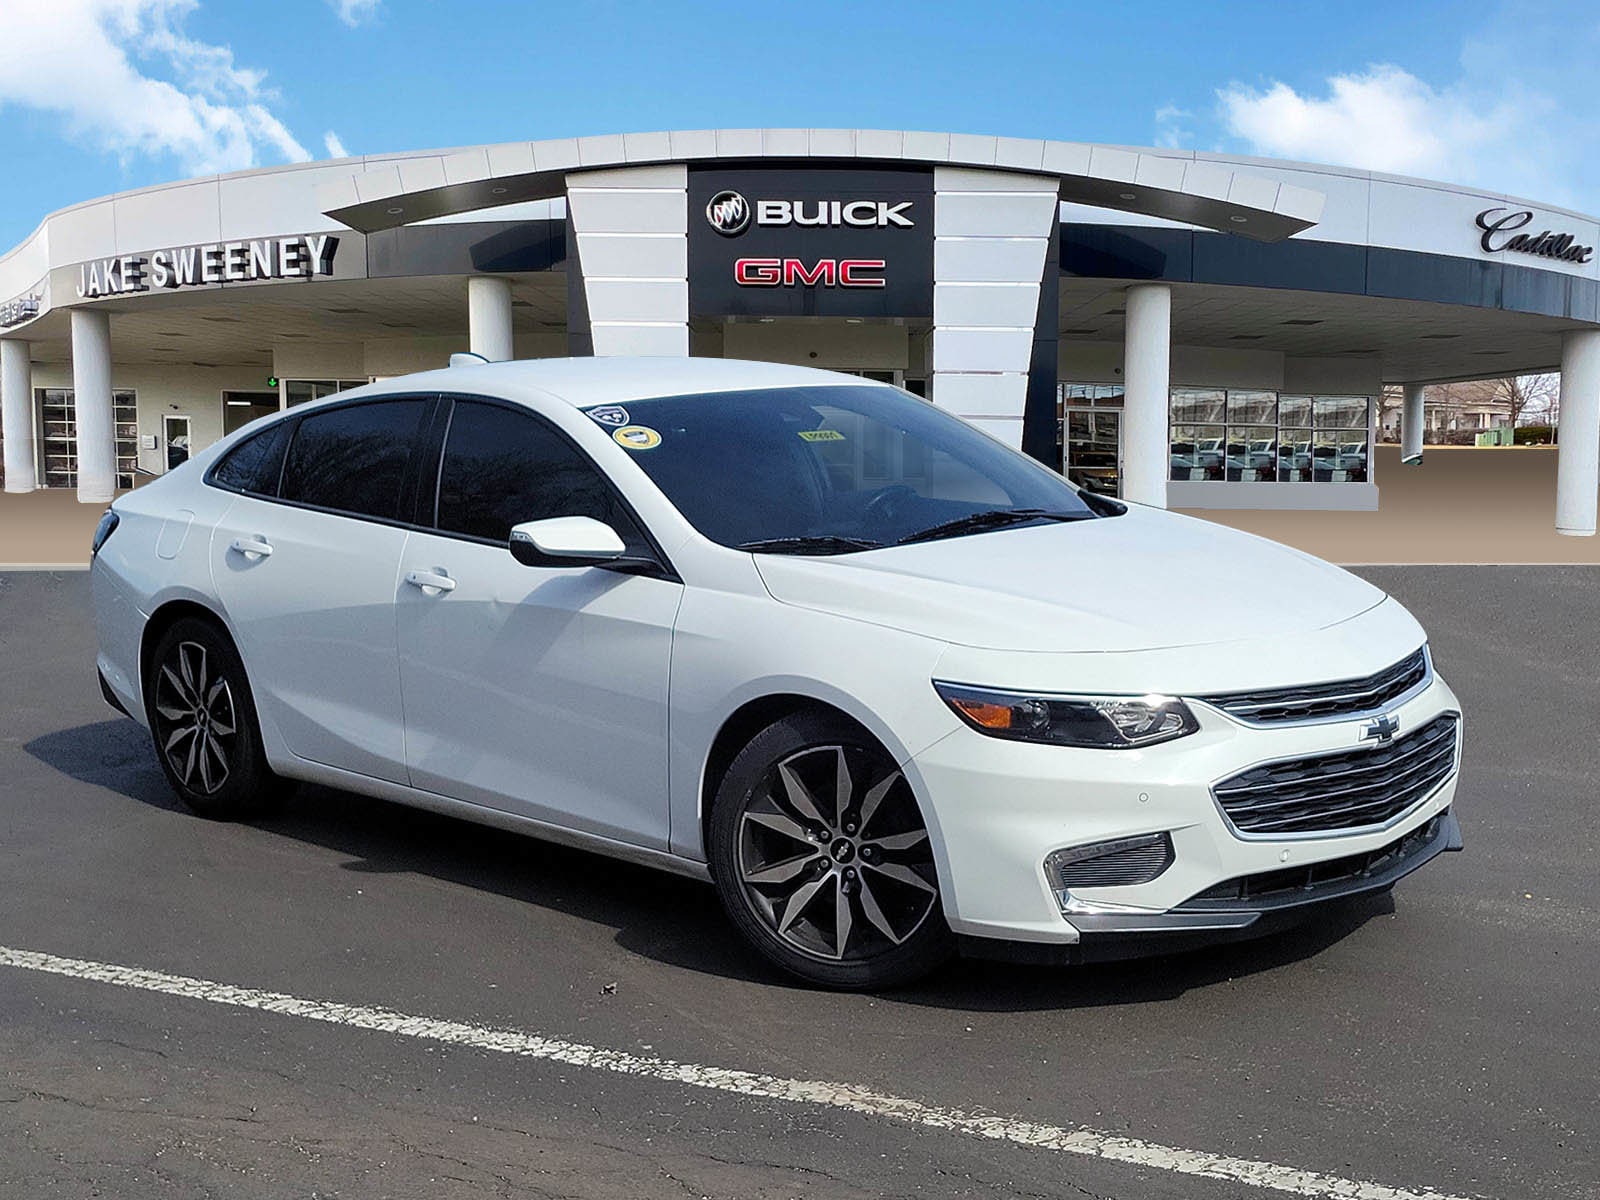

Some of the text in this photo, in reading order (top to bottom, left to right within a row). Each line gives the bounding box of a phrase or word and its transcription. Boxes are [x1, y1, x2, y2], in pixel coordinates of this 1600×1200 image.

[757, 200, 915, 227] BUICK
[1475, 207, 1593, 264] Cadillac
[76, 234, 330, 298] JAKE SWEENEY
[734, 258, 886, 287] GMC
